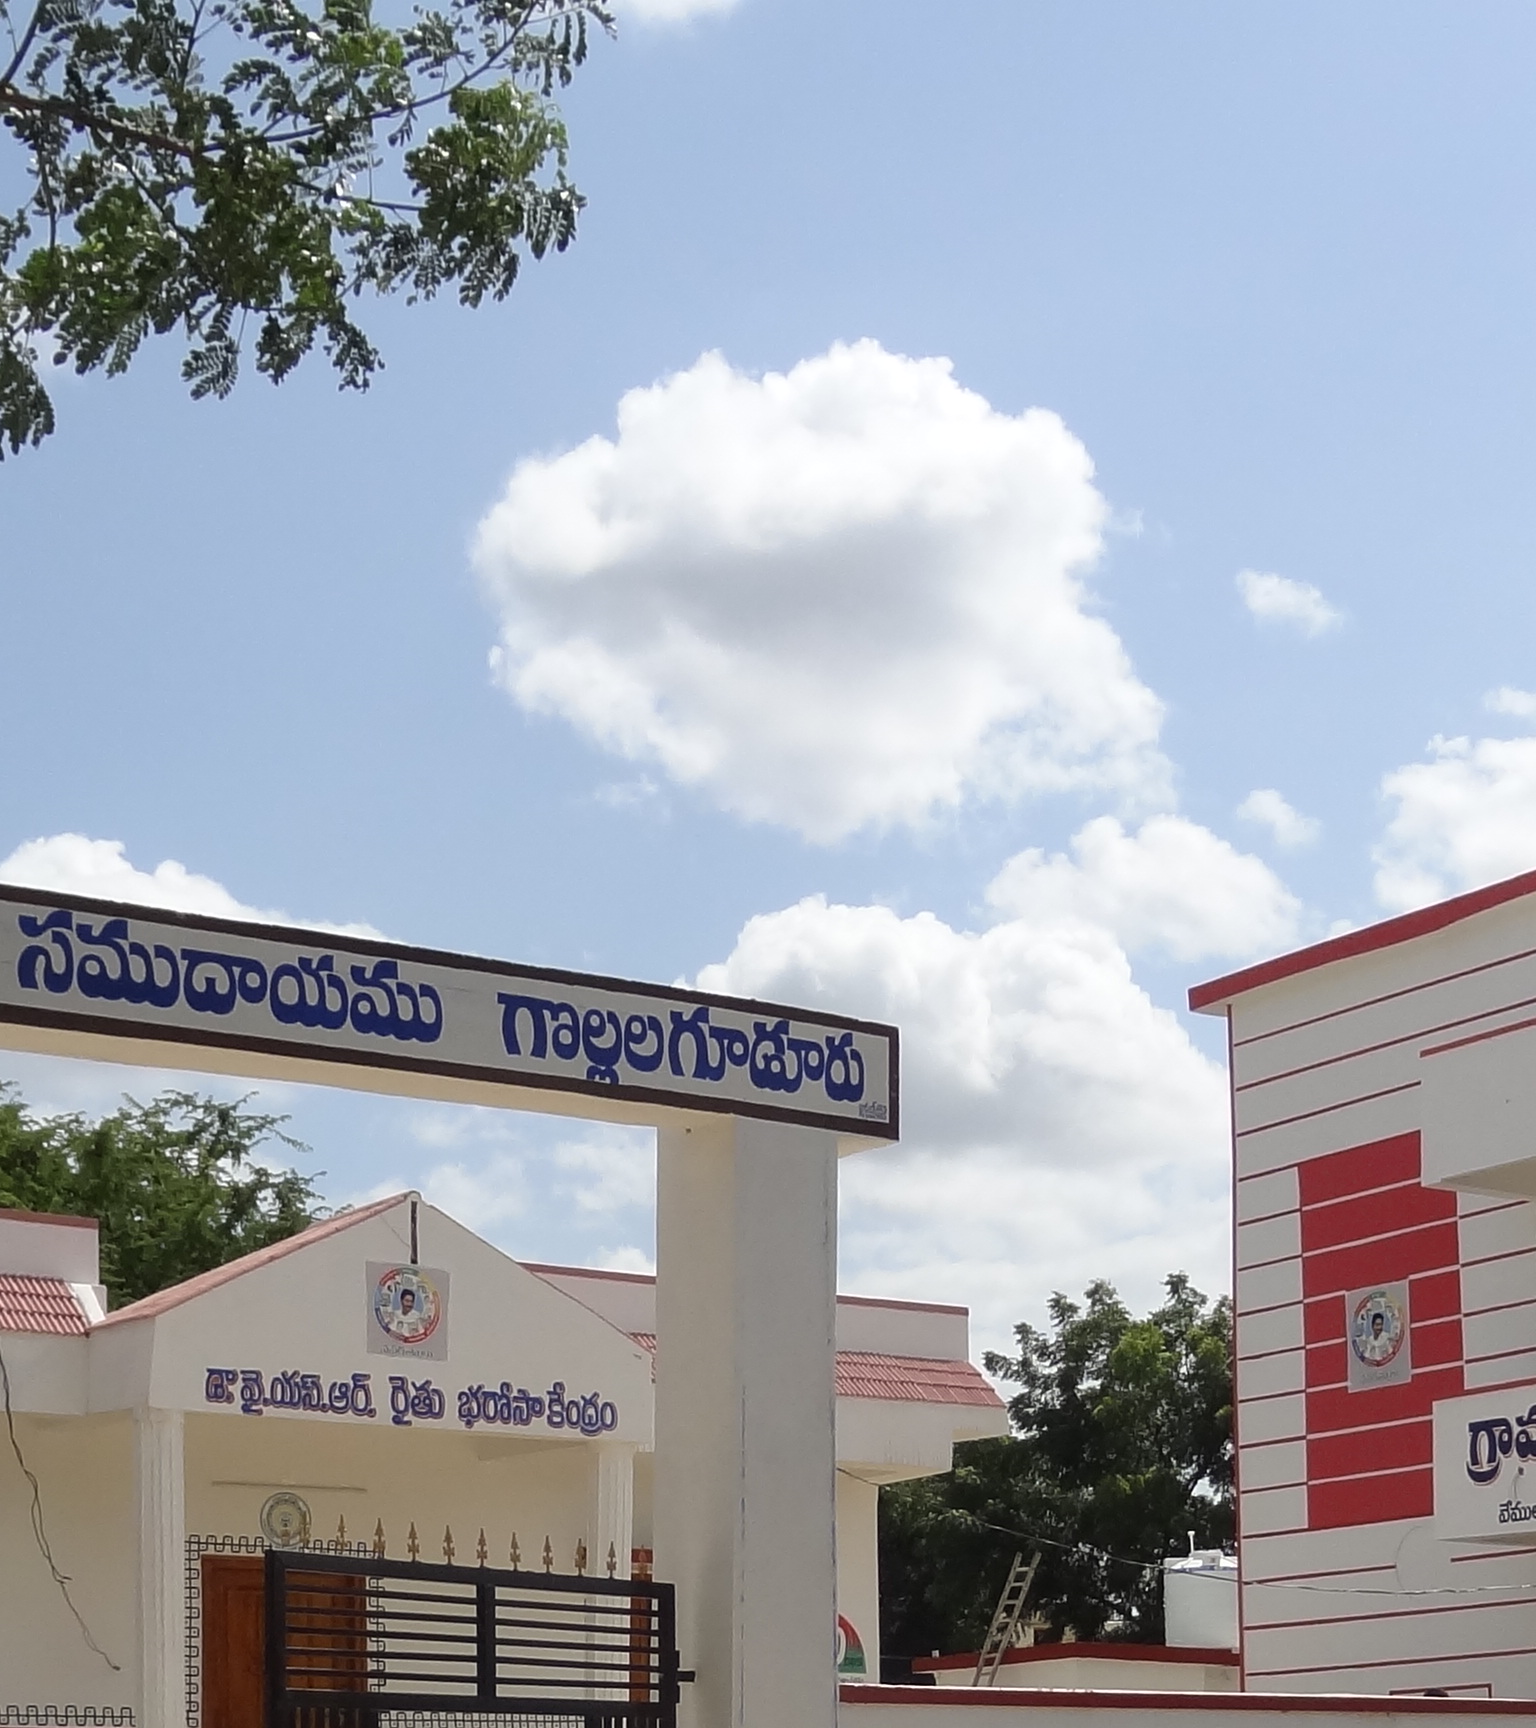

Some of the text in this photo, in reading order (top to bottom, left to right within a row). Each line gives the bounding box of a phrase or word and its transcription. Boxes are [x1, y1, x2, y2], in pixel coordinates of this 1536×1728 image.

[17, 909, 444, 1043] సముదాయము
[389, 1375, 446, 1426] రైతు
[458, 1381, 546, 1429] భరోసా
[546, 1381, 618, 1437] కేంద్రం
